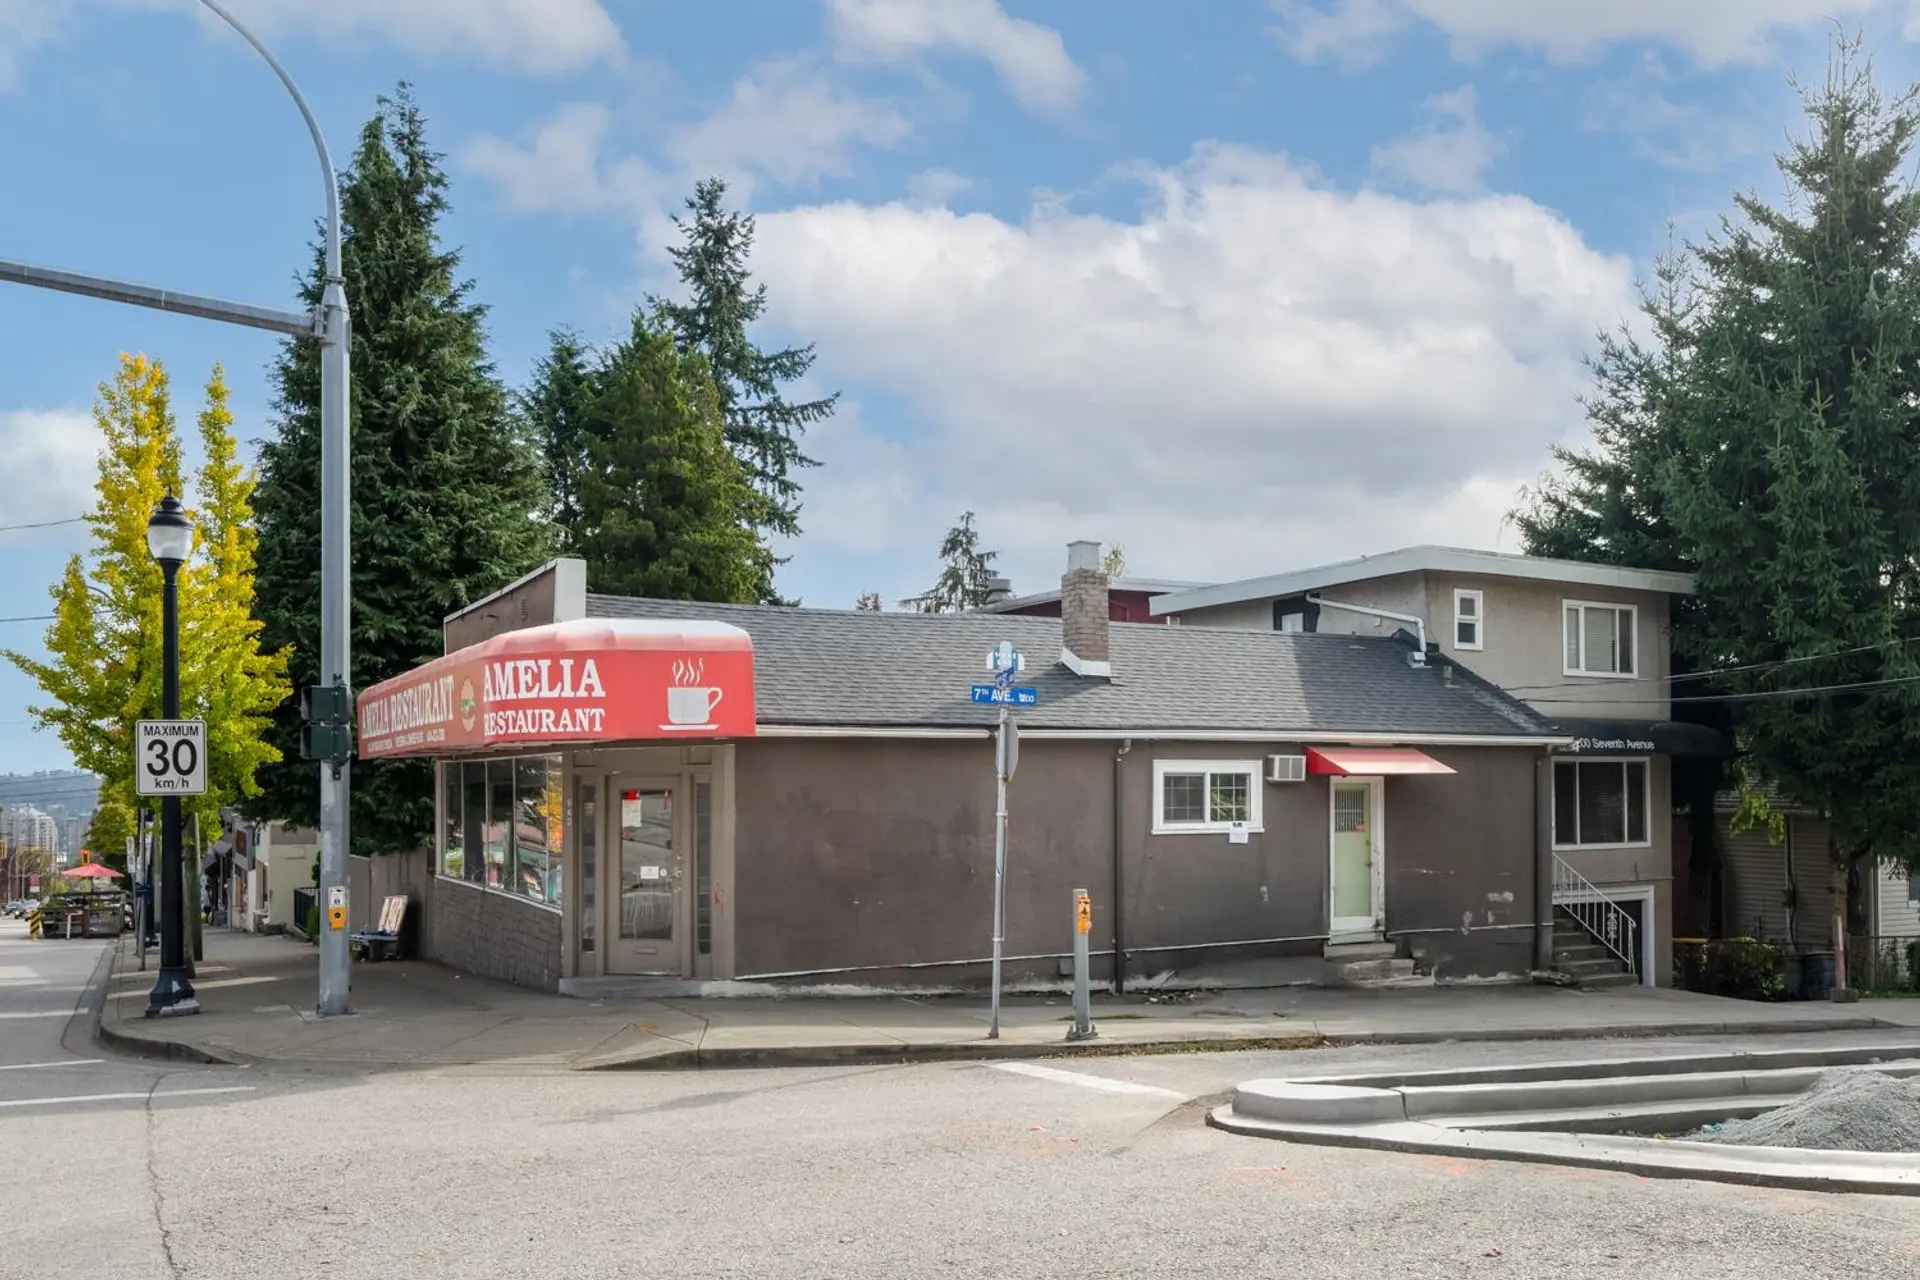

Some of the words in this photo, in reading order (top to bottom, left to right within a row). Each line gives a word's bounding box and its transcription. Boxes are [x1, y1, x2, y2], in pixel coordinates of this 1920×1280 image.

[483, 658, 606, 702] AMELIA
[361, 697, 390, 740] AMELIA
[390, 674, 454, 733] RESTAURANT
[143, 725, 199, 737] MAXIMUM
[484, 708, 605, 736] RESTAURANT
[146, 739, 197, 776] 30
[1592, 738, 1626, 749] Seventh
[1626, 739, 1655, 750] Avenue
[154, 777, 190, 789] km/h
